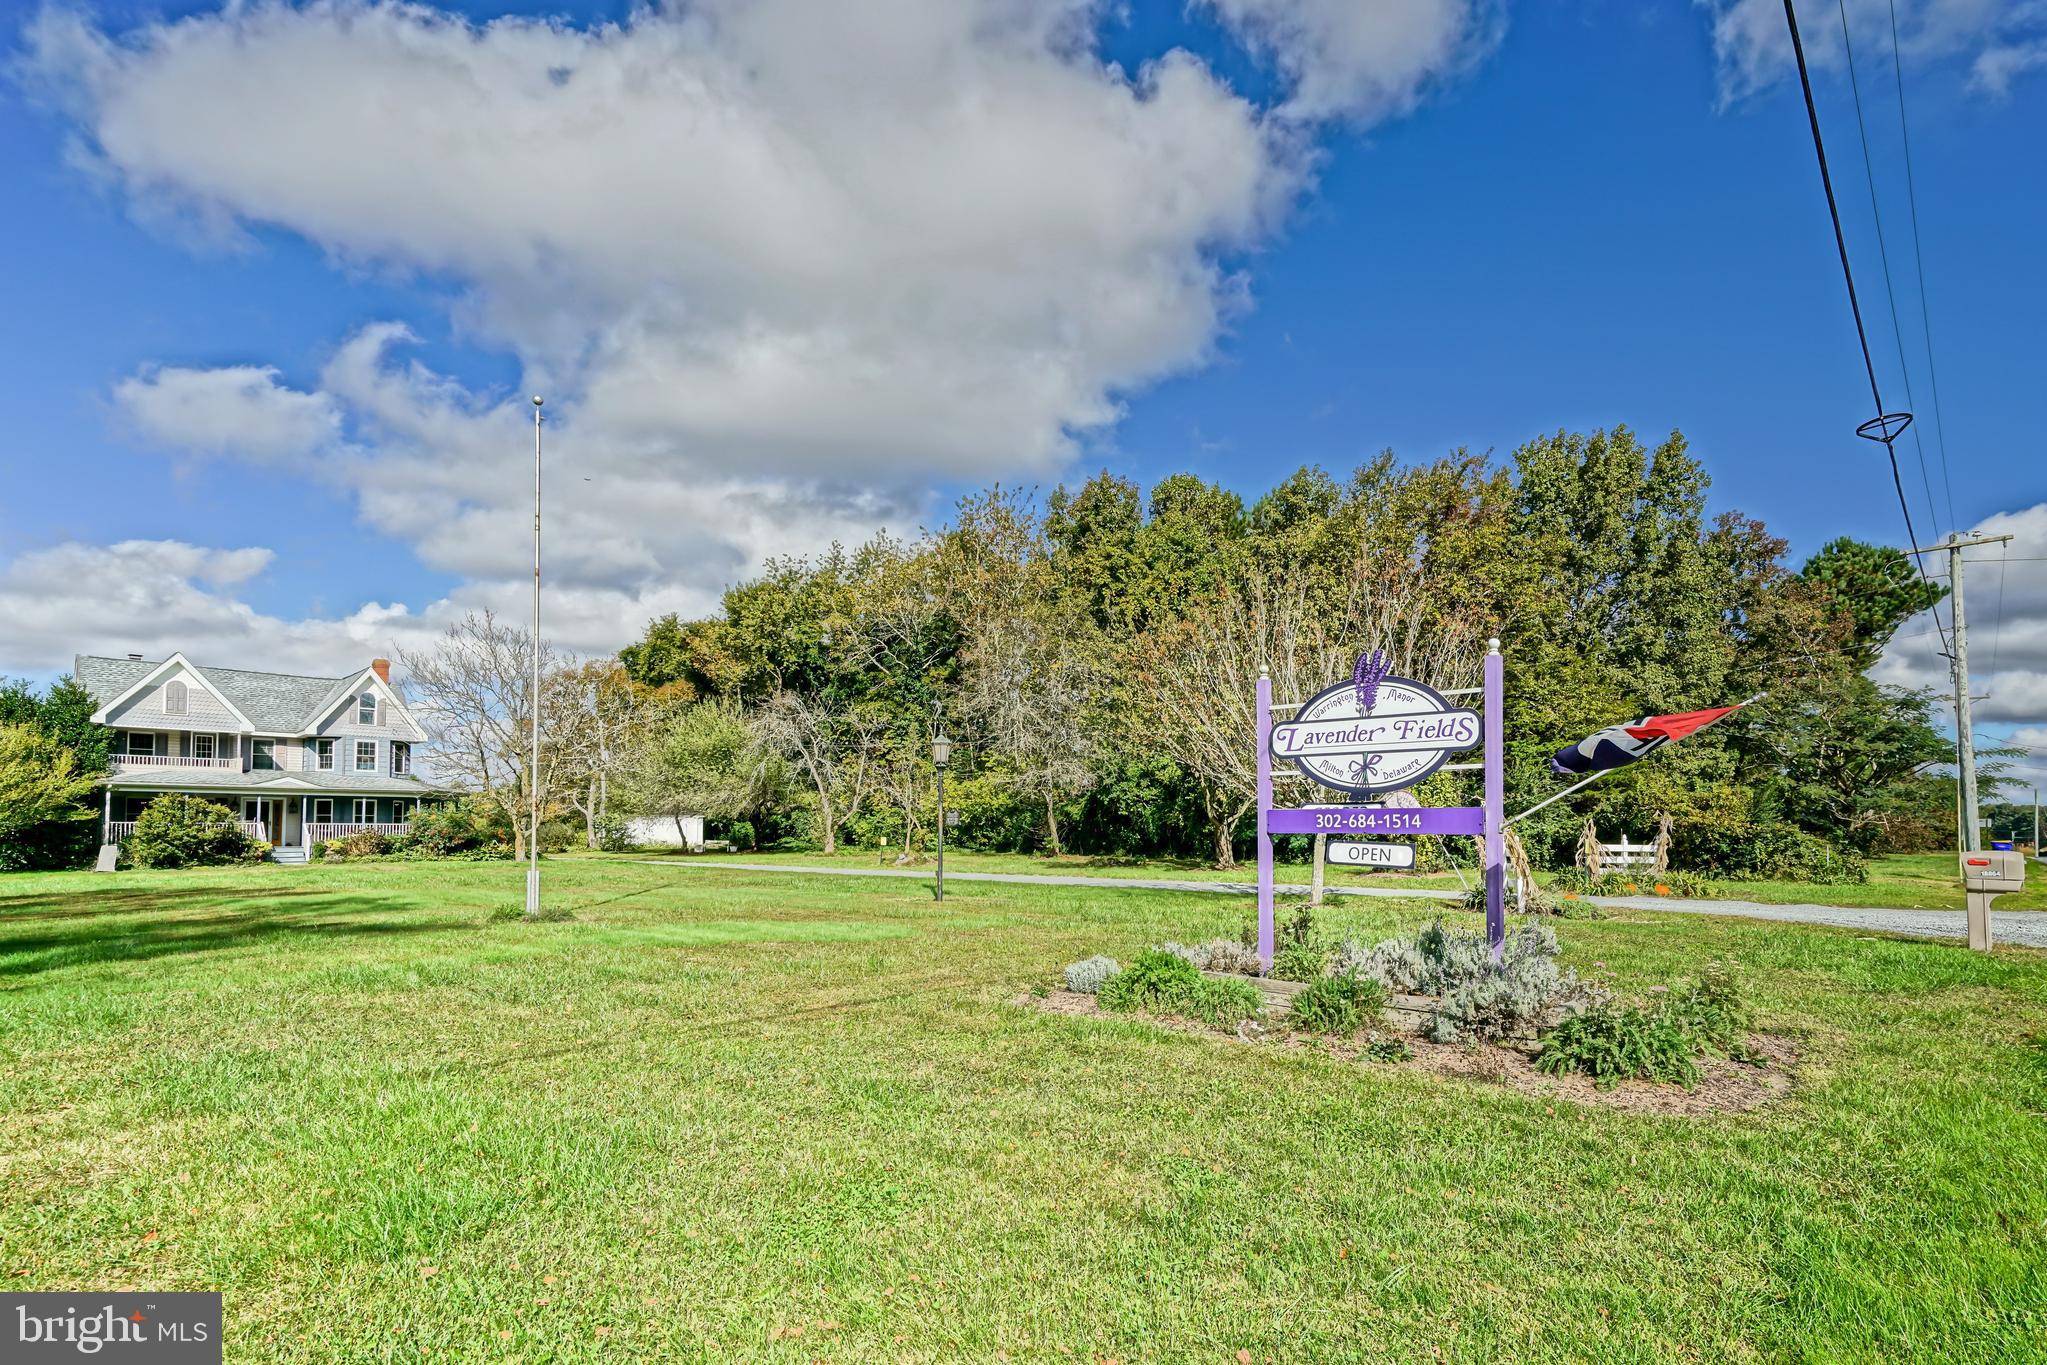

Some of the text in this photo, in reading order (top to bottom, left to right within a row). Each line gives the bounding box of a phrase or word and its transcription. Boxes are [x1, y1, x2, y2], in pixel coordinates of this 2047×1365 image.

[1312, 688, 1416, 719] Warrington Manor
[1277, 725, 1385, 752] Lavender
[1319, 758, 1422, 780] Milton Delaware
[1315, 814, 1422, 829] 302-684-1514
[1348, 847, 1391, 862] OPEN
